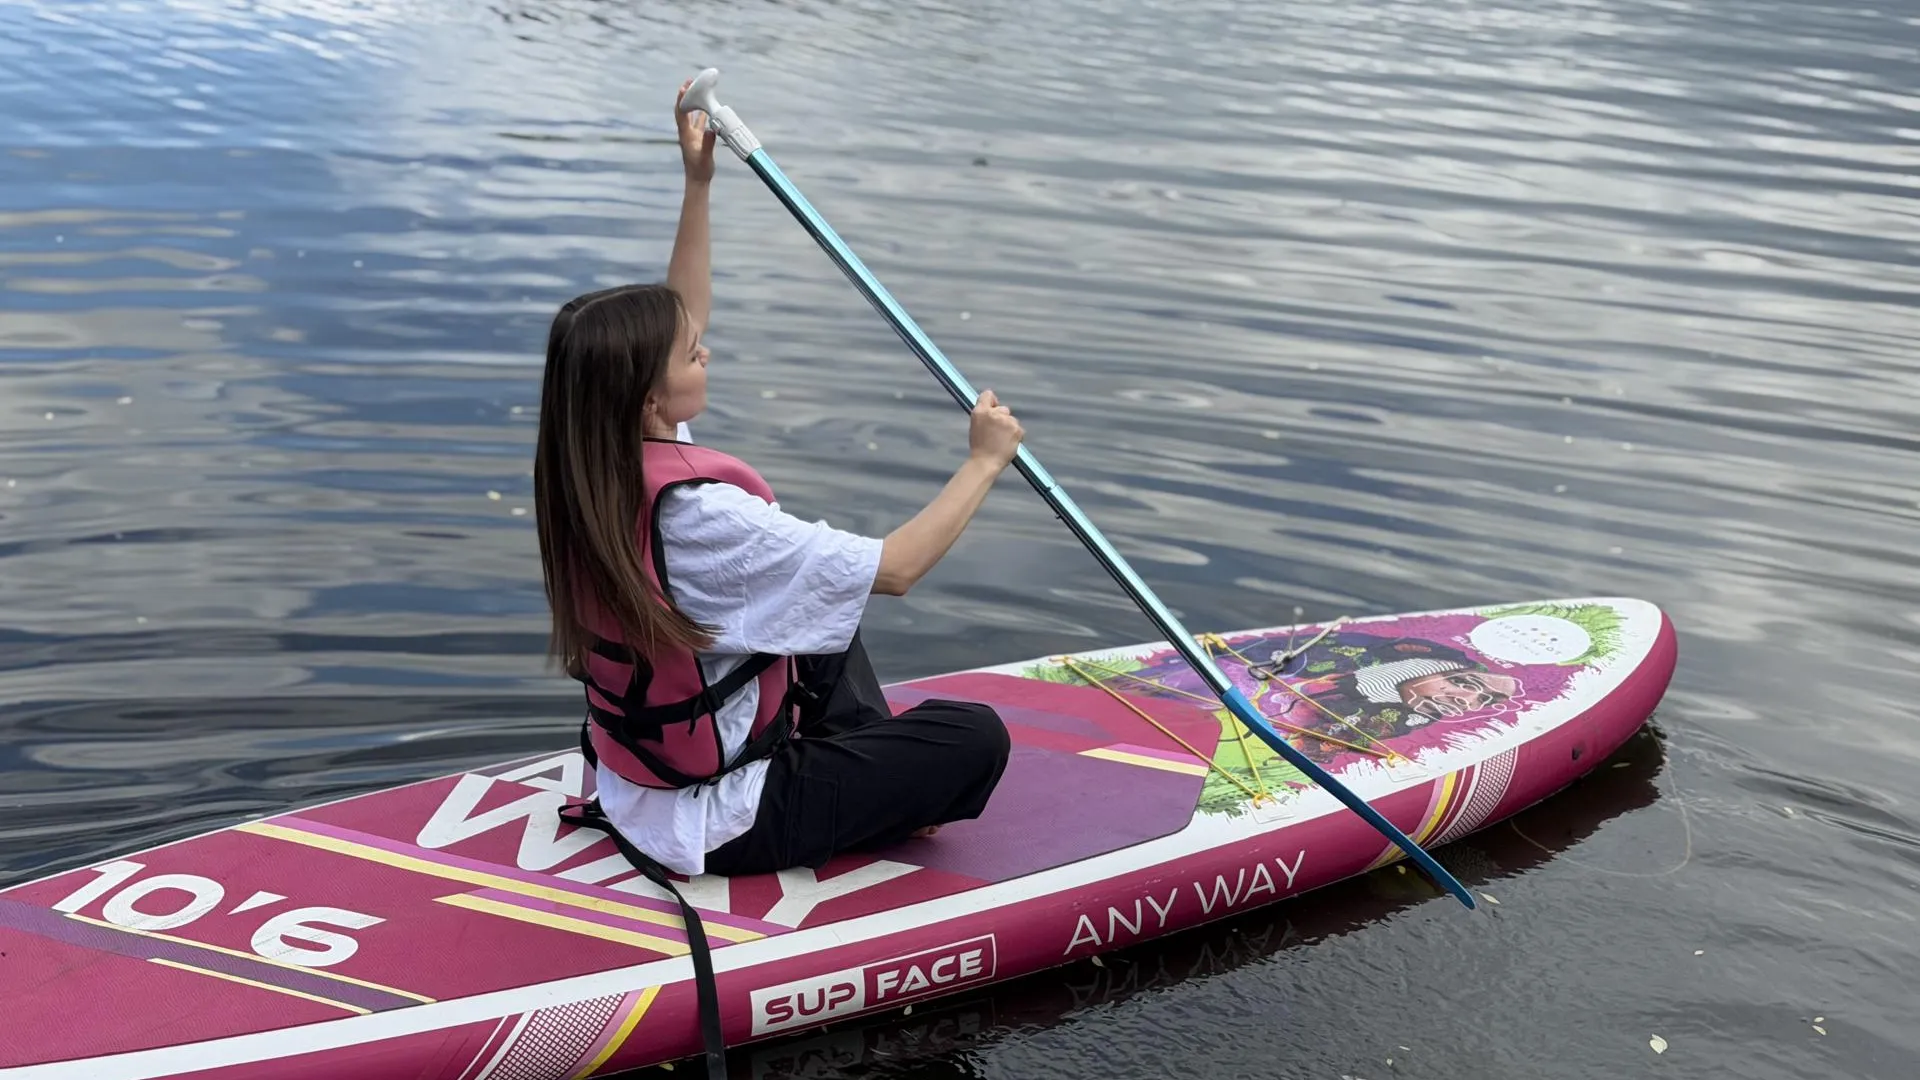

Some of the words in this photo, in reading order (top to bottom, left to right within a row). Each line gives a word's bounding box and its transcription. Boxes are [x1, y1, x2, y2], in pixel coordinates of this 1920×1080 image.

[1063, 888, 1178, 955] ANY
[1193, 850, 1305, 914] WAY
[765, 981, 856, 1025] SUP
[877, 948, 983, 999] FACE
